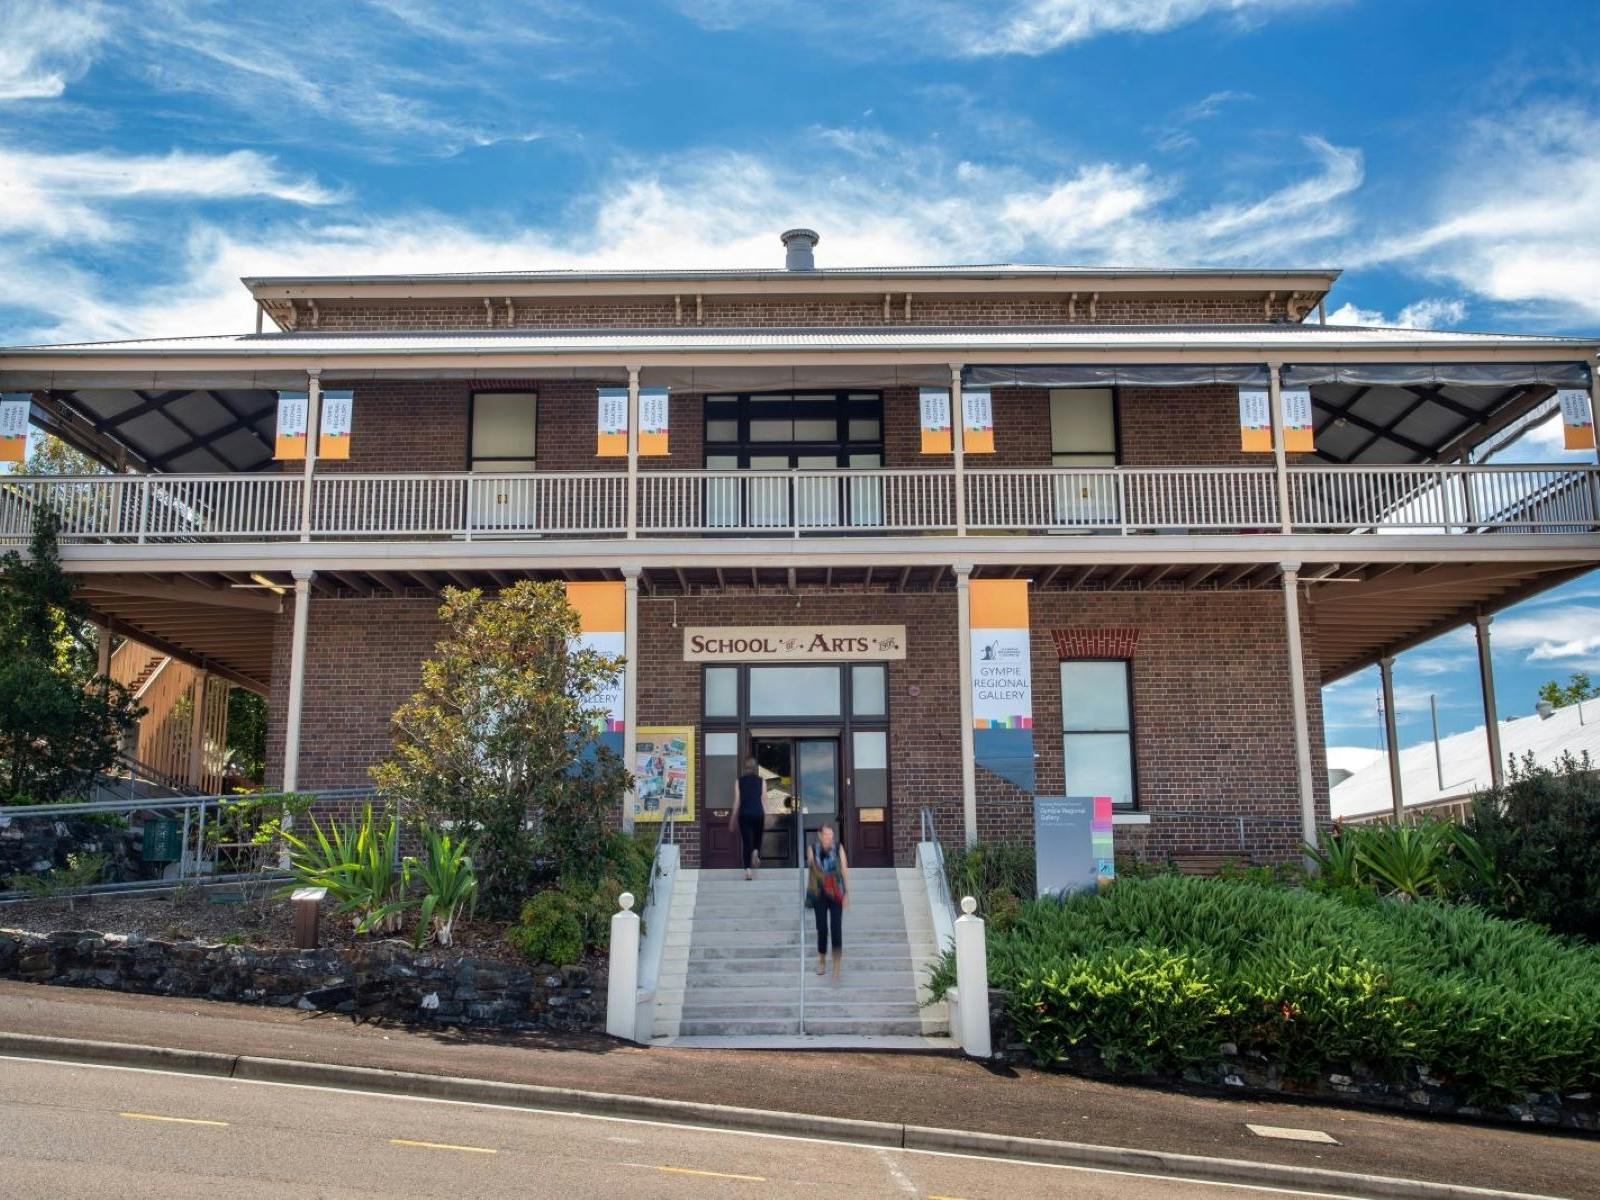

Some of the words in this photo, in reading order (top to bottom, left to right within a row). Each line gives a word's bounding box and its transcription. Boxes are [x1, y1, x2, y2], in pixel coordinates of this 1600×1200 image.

[691, 635, 777, 653] SCHOOL
[808, 634, 869, 652] ARTS
[980, 668, 1021, 676] GYMPIE
[974, 679, 1028, 688] REGIONAL
[978, 691, 1024, 700] GALLERY
